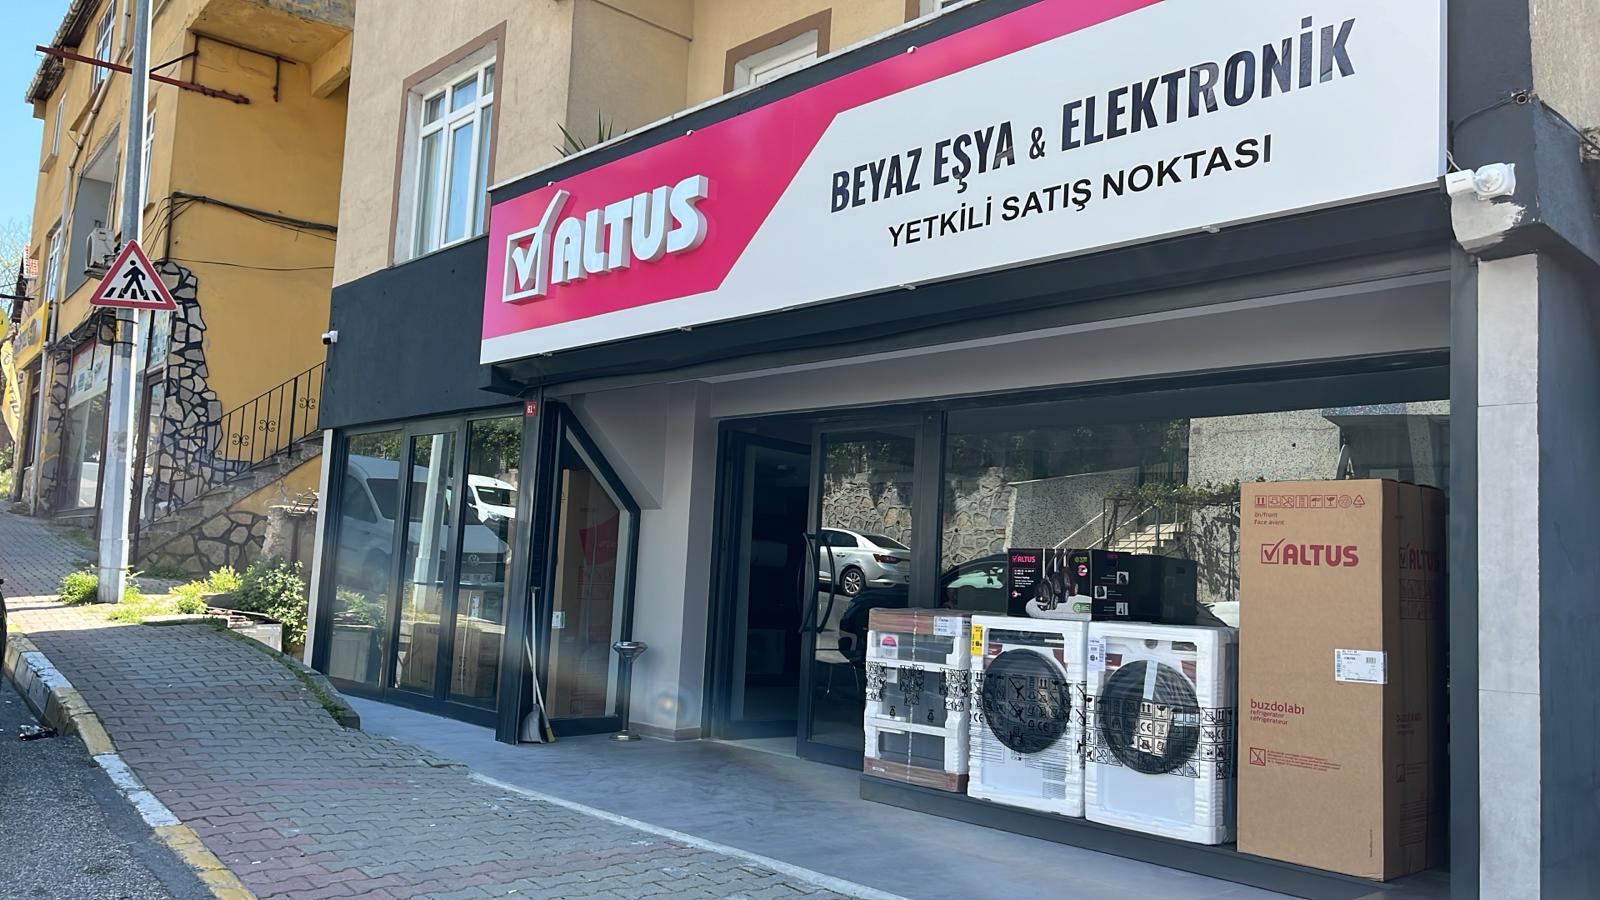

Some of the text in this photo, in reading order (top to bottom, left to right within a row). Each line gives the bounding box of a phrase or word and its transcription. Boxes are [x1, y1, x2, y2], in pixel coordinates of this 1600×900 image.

[831, 15, 1356, 213] BEYAZ EŞYA & ELEKTRONİK
[888, 134, 1272, 248] YETKİLİ SATIŞ NOKTASI
[551, 174, 709, 285] ALTUS
[1017, 555, 1036, 563] ALTUS
[1282, 543, 1360, 567] ALTUS
[1250, 698, 1305, 715] buzdolabı
[1140, 723, 1152, 732] CE
